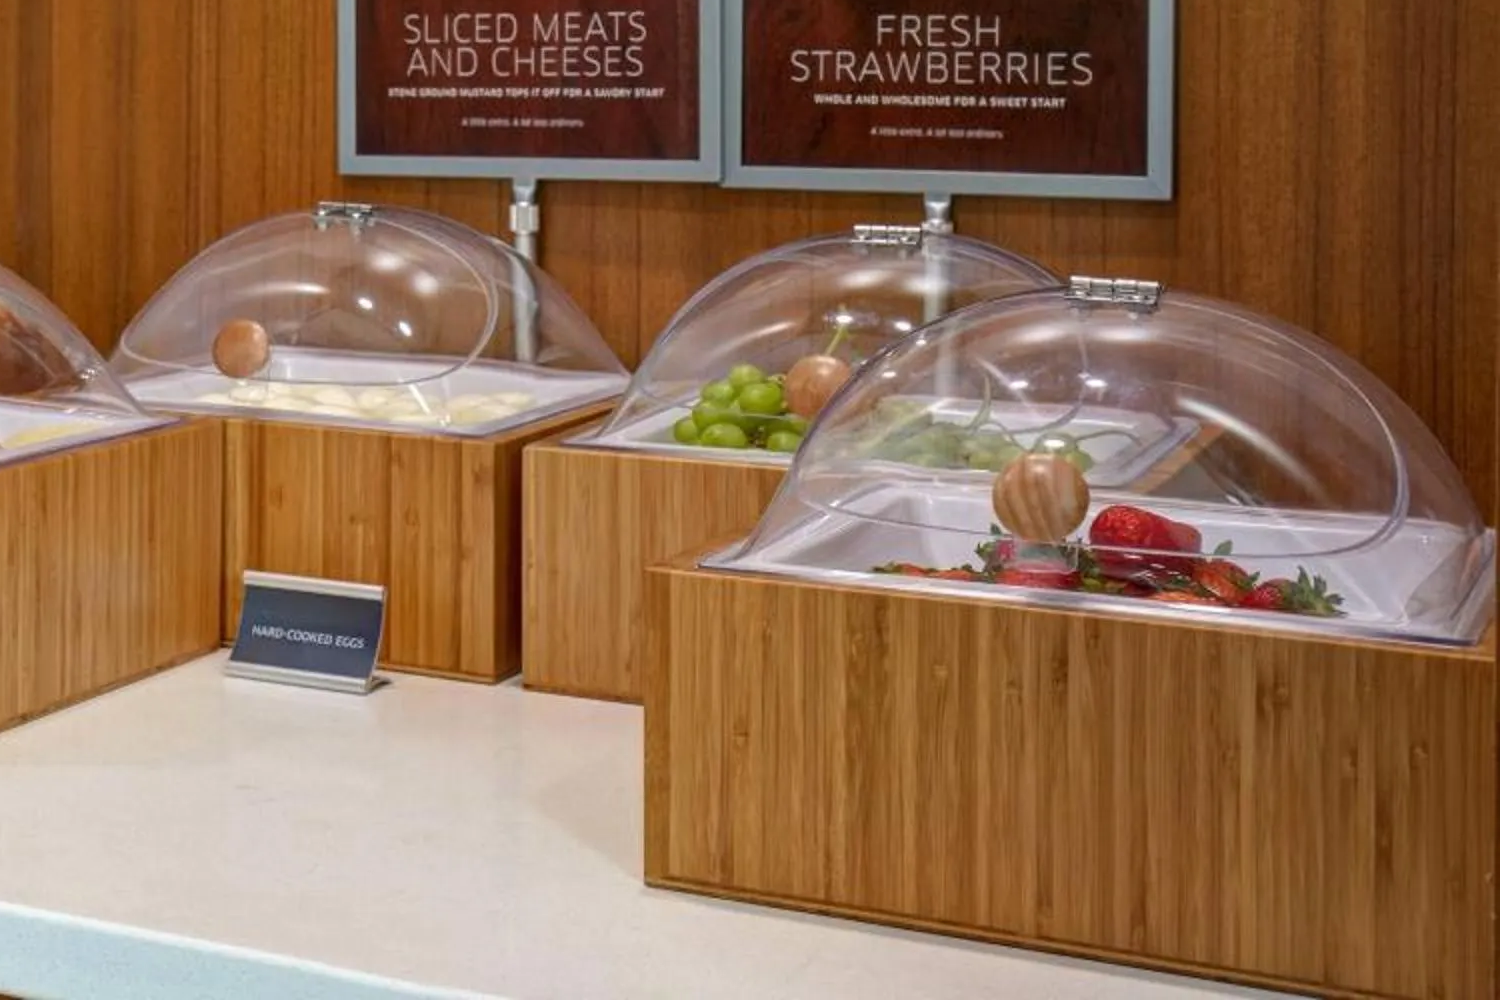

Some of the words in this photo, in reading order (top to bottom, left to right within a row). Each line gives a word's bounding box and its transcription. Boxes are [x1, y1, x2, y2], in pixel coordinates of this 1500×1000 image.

[403, 13, 518, 45] SLICED
[532, 11, 648, 43] MEATS
[876, 15, 1000, 47] FRESH
[406, 47, 479, 78] AND
[491, 46, 644, 78] CHEESES
[790, 50, 1094, 86] STRAWBERRIES
[459, 87, 504, 98] MUSTARD
[505, 87, 529, 99] TOPS
[531, 87, 540, 98] IT
[541, 87, 561, 98] OFF
[562, 87, 582, 98] FOR
[584, 87, 592, 98] A
[593, 87, 632, 99] SAVORY
[633, 87, 665, 98] START
[813, 93, 853, 105] WHOLE
[855, 95, 879, 105] AND
[881, 95, 951, 108] WHOLESOME
[953, 96, 976, 108] FOR
[978, 96, 988, 108] A
[989, 96, 1028, 109] SWEET
[1030, 97, 1066, 109] START
[252, 623, 333, 646] HARD-COOKED
[335, 635, 365, 649] EGGS
